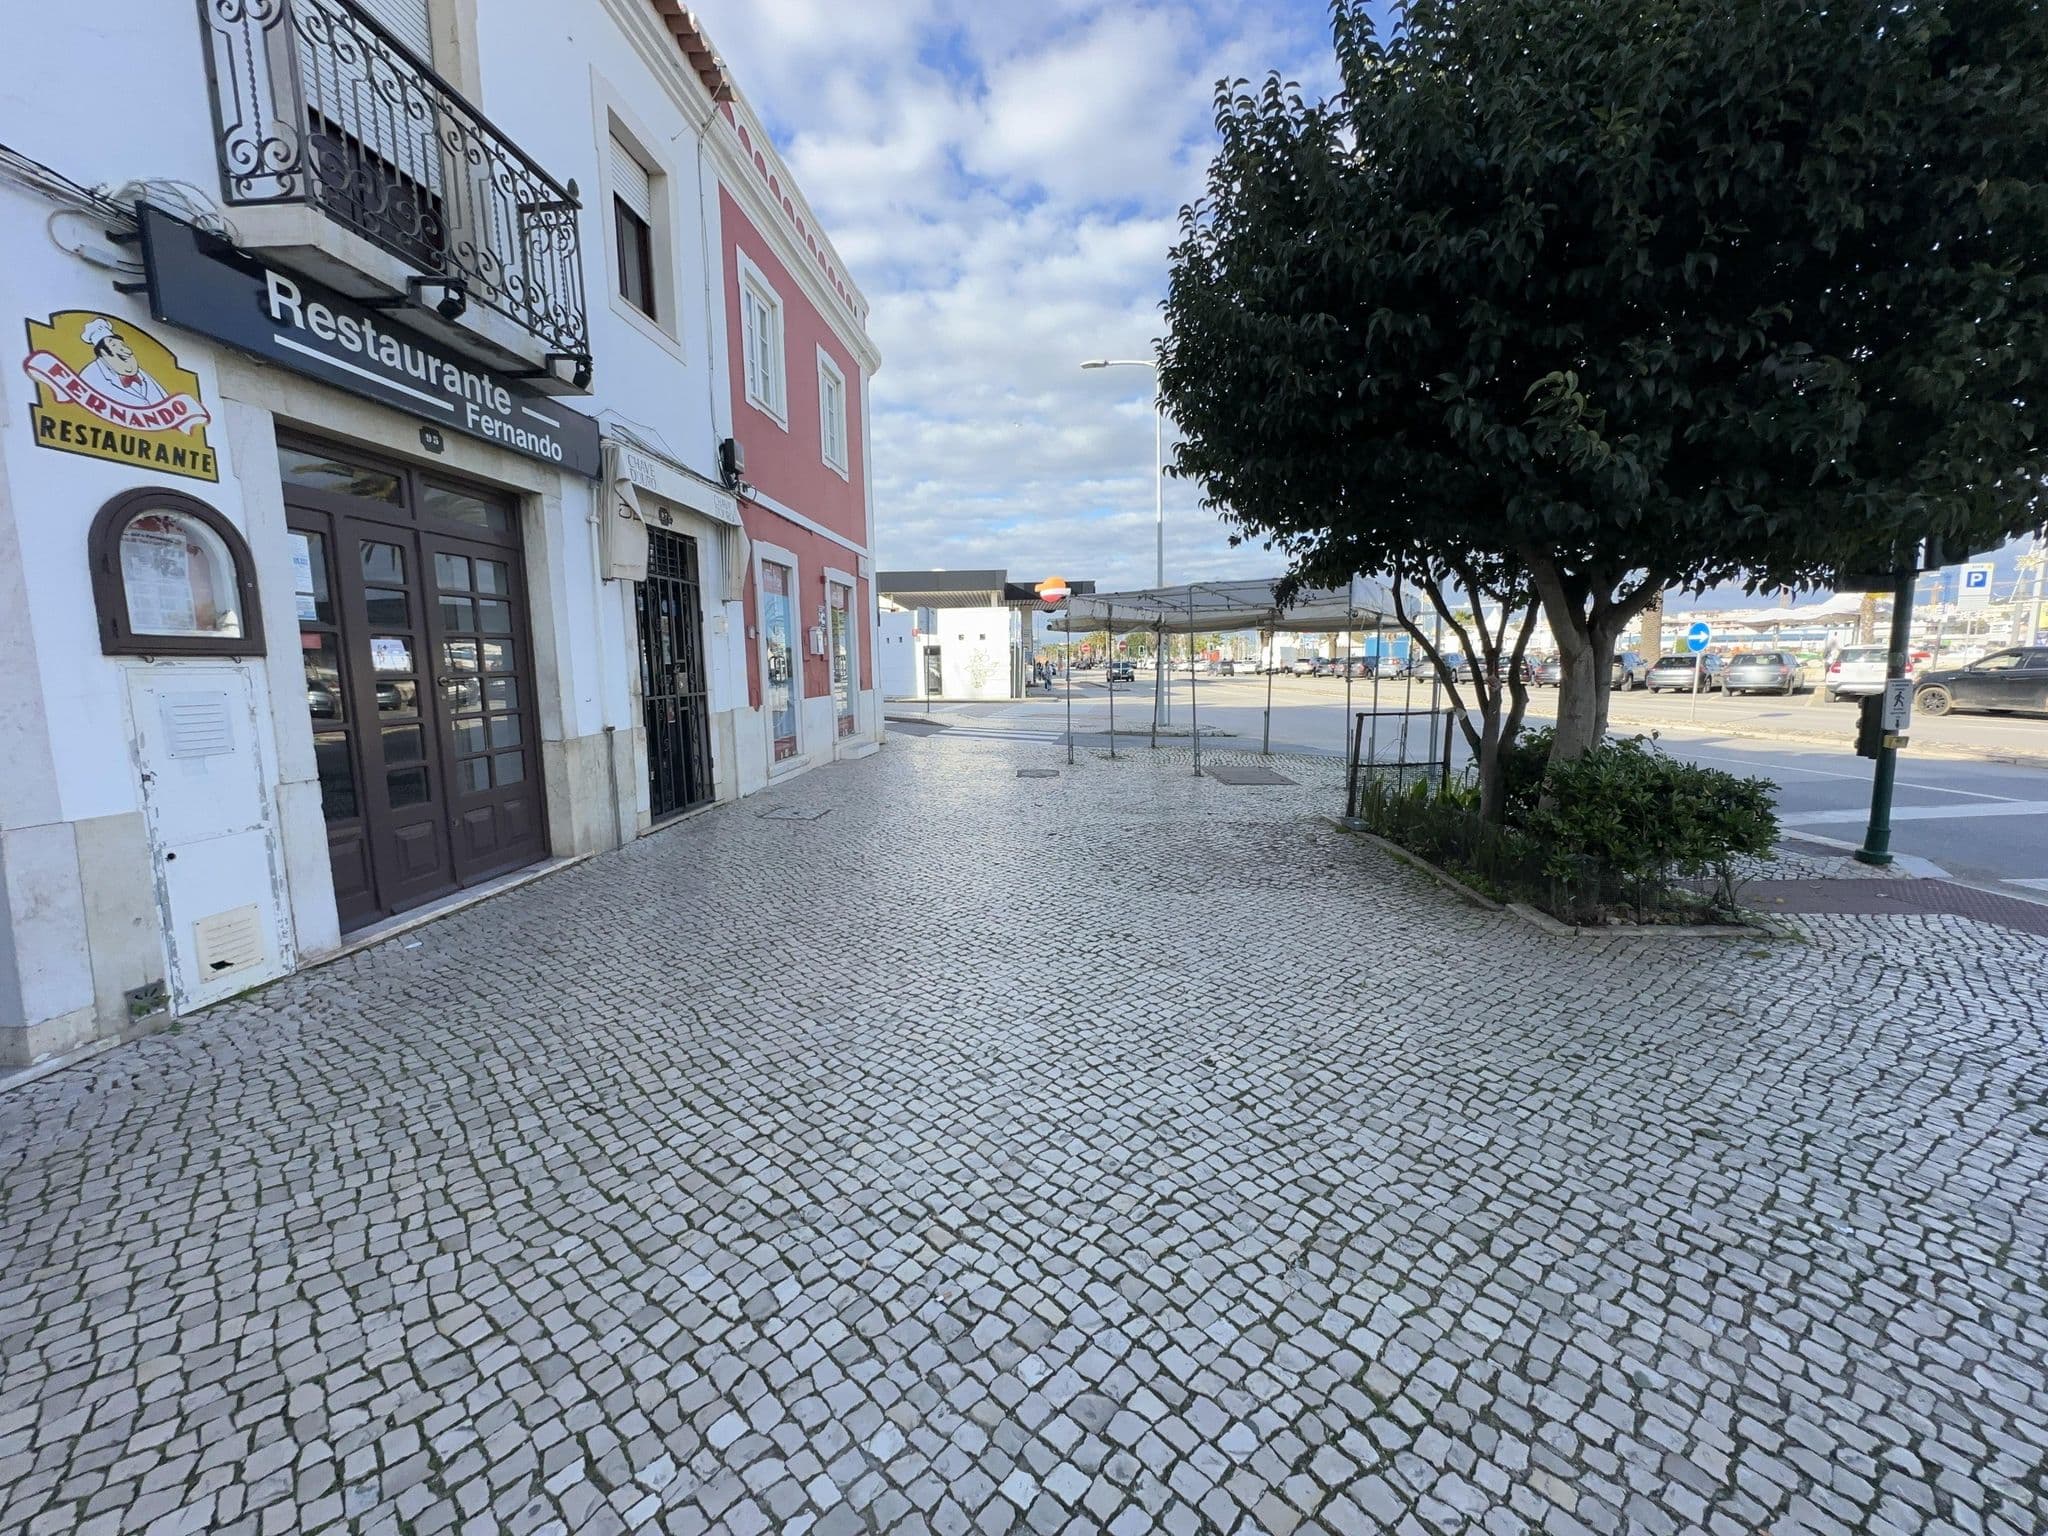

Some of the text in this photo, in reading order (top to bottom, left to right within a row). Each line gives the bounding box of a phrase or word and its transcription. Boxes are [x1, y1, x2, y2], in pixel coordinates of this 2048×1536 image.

[265, 269, 512, 415] Restaurante
[48, 363, 188, 428] FERNANDO
[40, 415, 211, 473] RESTAURANTE
[465, 402, 563, 461] Fernando
[627, 454, 656, 478] CHAVE
[1970, 573, 1983, 587] P
